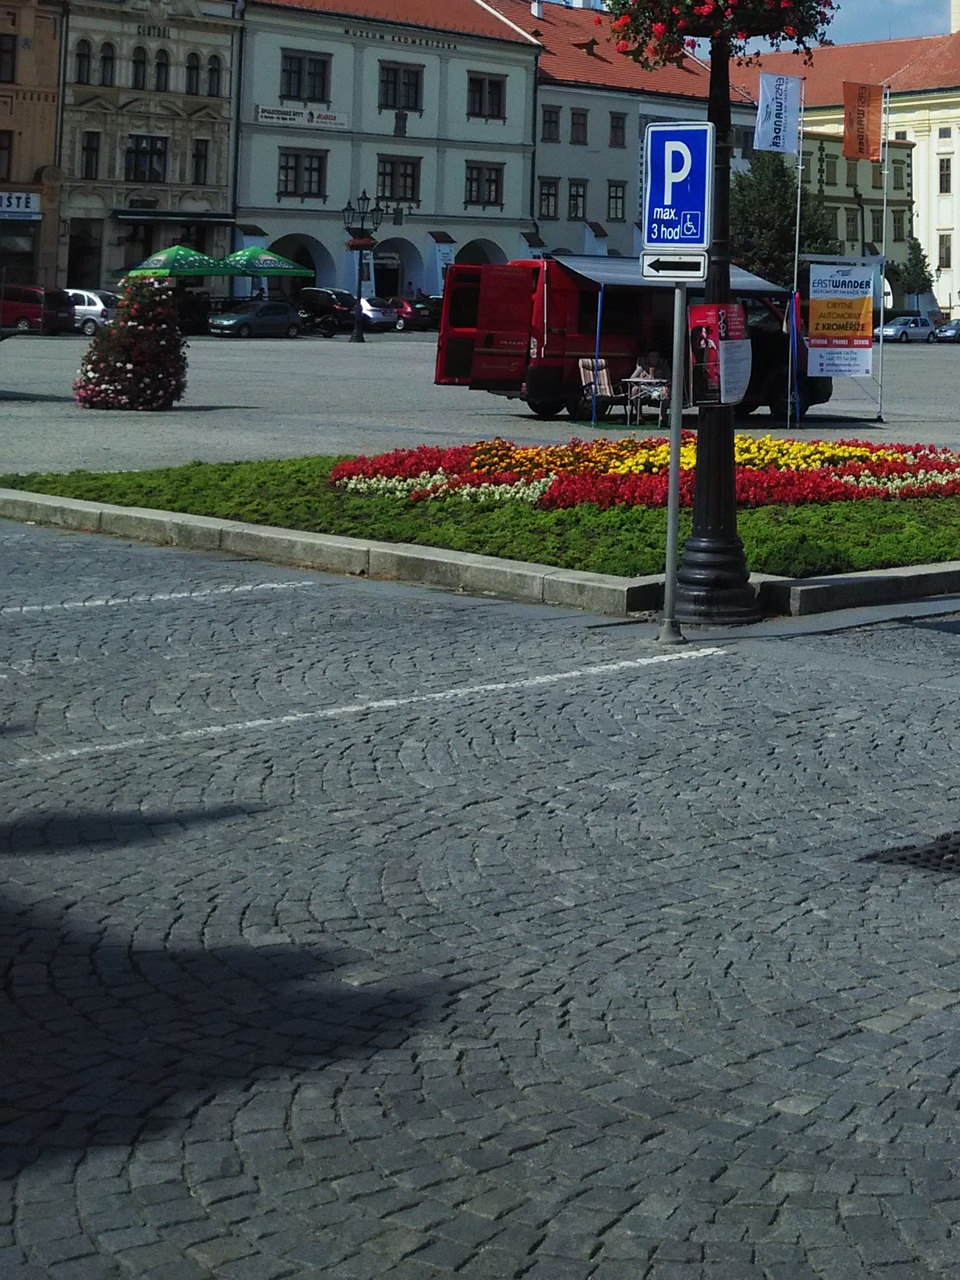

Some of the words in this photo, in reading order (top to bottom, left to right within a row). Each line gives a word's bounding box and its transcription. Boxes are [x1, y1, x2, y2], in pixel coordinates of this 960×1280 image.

[344, 28, 385, 40] MUZEUM
[664, 141, 692, 205] P
[653, 207, 678, 220] max.
[651, 224, 658, 239] 3
[661, 224, 680, 239] hod
[812, 279, 871, 289] EASTWANDER
[826, 301, 853, 309] OBYTNÉ
[815, 323, 820, 331] Z
